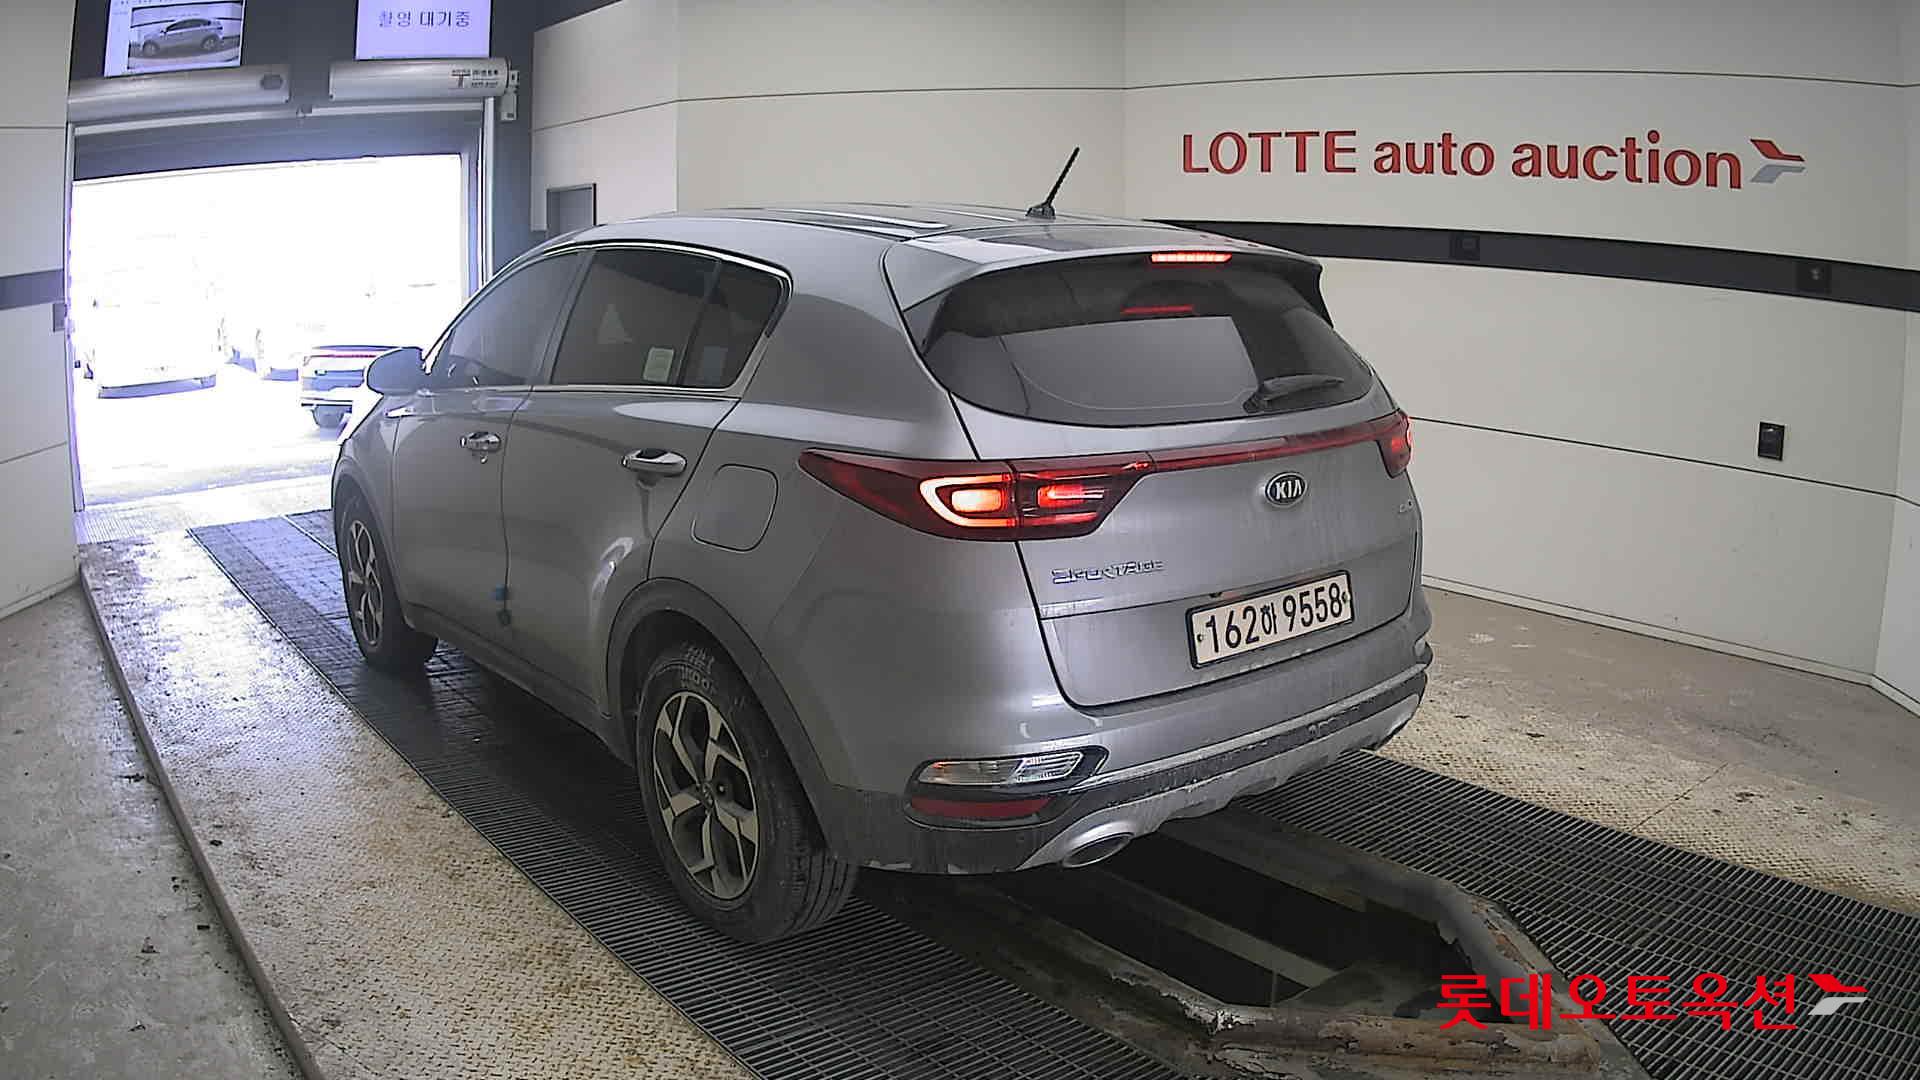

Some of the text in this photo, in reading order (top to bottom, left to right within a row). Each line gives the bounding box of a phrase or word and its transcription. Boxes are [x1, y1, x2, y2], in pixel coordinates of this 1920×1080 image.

[420, 10, 470, 28] 대기중
[1183, 129, 1742, 189] LOTTE auto auction
[1274, 479, 1303, 500] KIA
